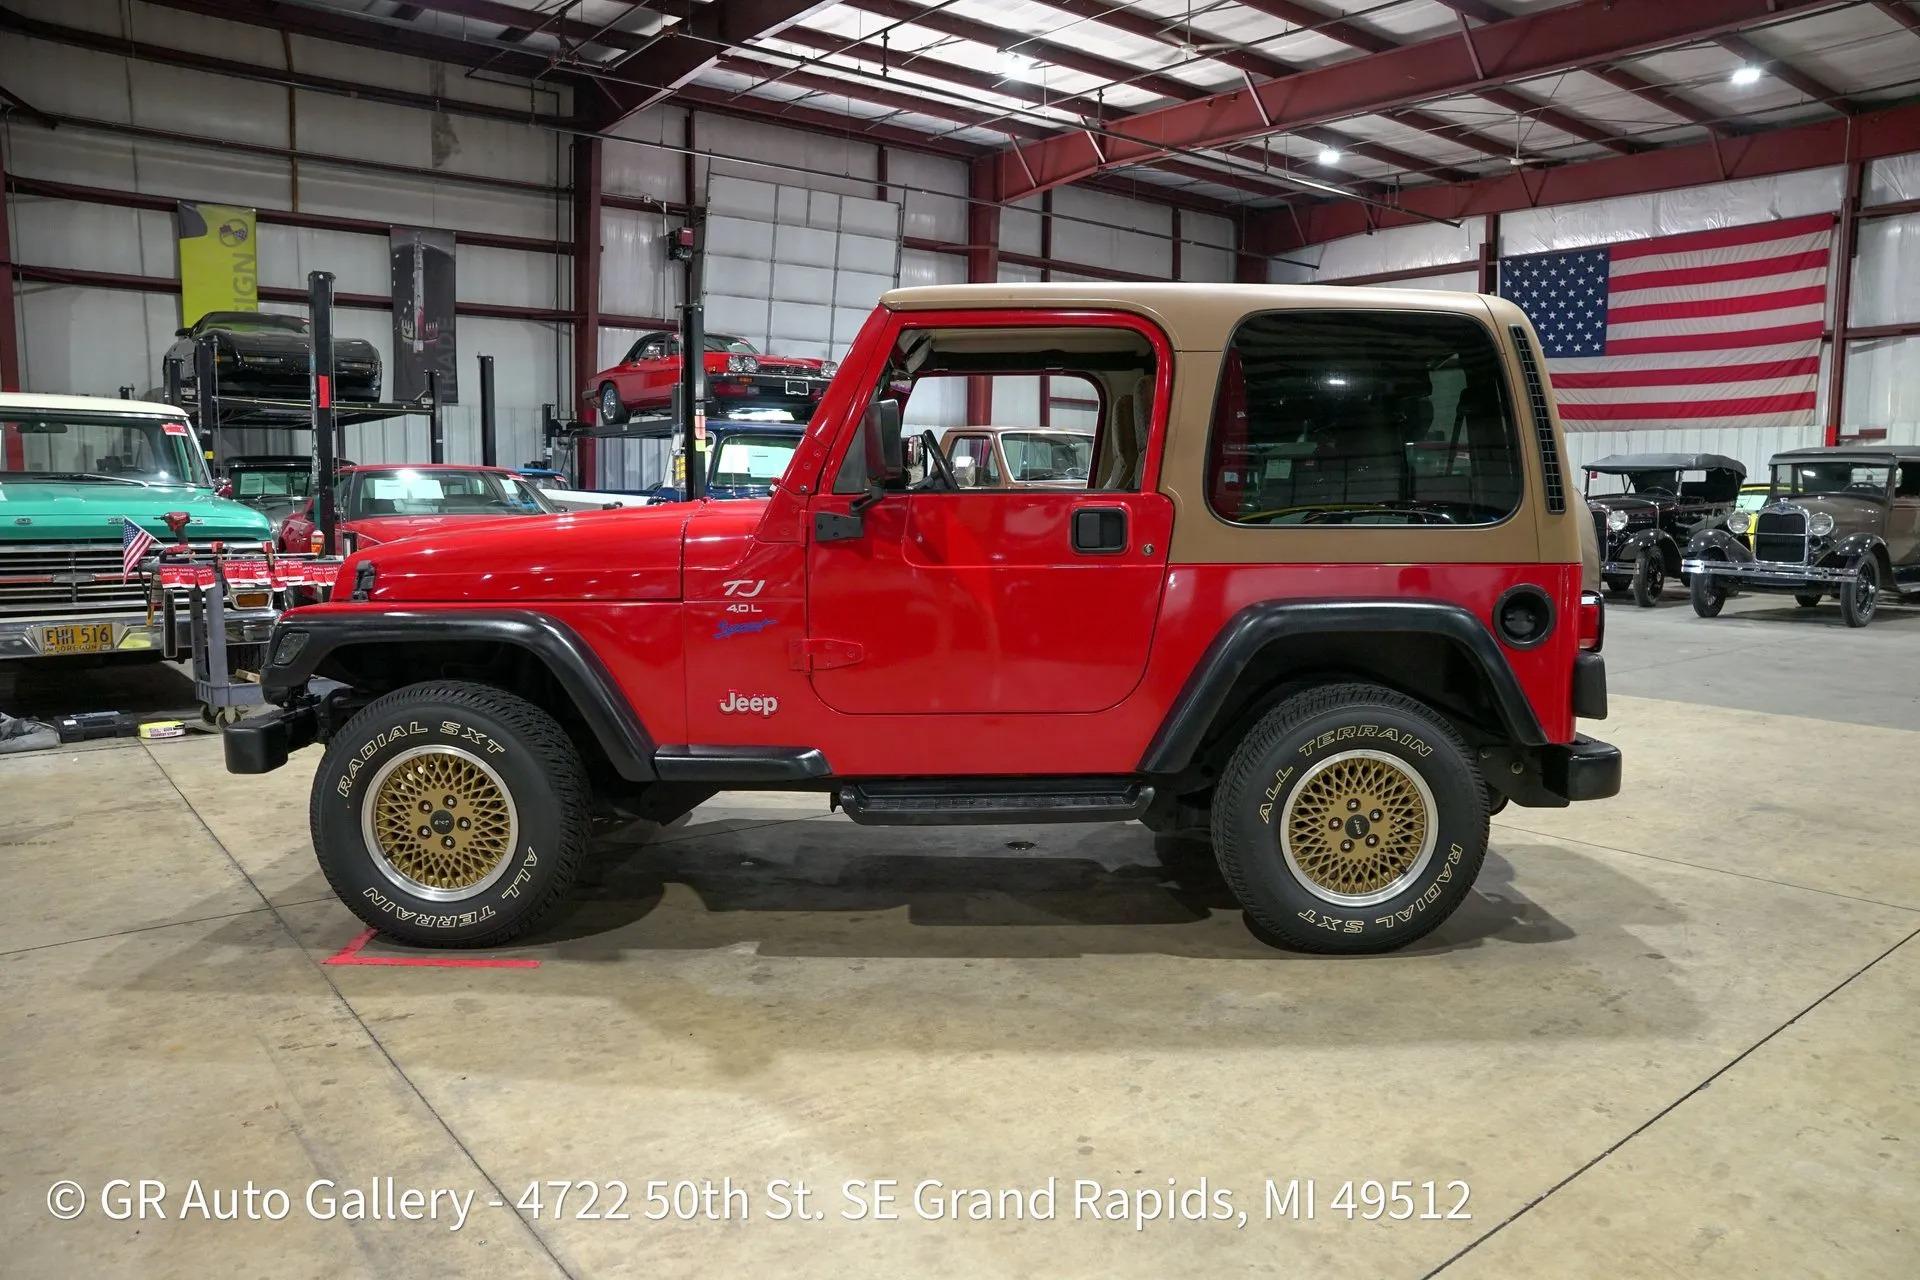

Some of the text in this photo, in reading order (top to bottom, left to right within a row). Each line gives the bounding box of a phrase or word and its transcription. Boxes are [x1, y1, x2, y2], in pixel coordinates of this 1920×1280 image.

[722, 579, 766, 598] TJ
[81, 627, 109, 643] 516
[719, 691, 778, 716] Jeep
[337, 721, 505, 797] RADIAL SXT
[1259, 725, 1433, 824] ALL TERRAIN
[363, 846, 538, 928] ALL TERRAIN
[1298, 844, 1463, 933] RADIAL SXT
